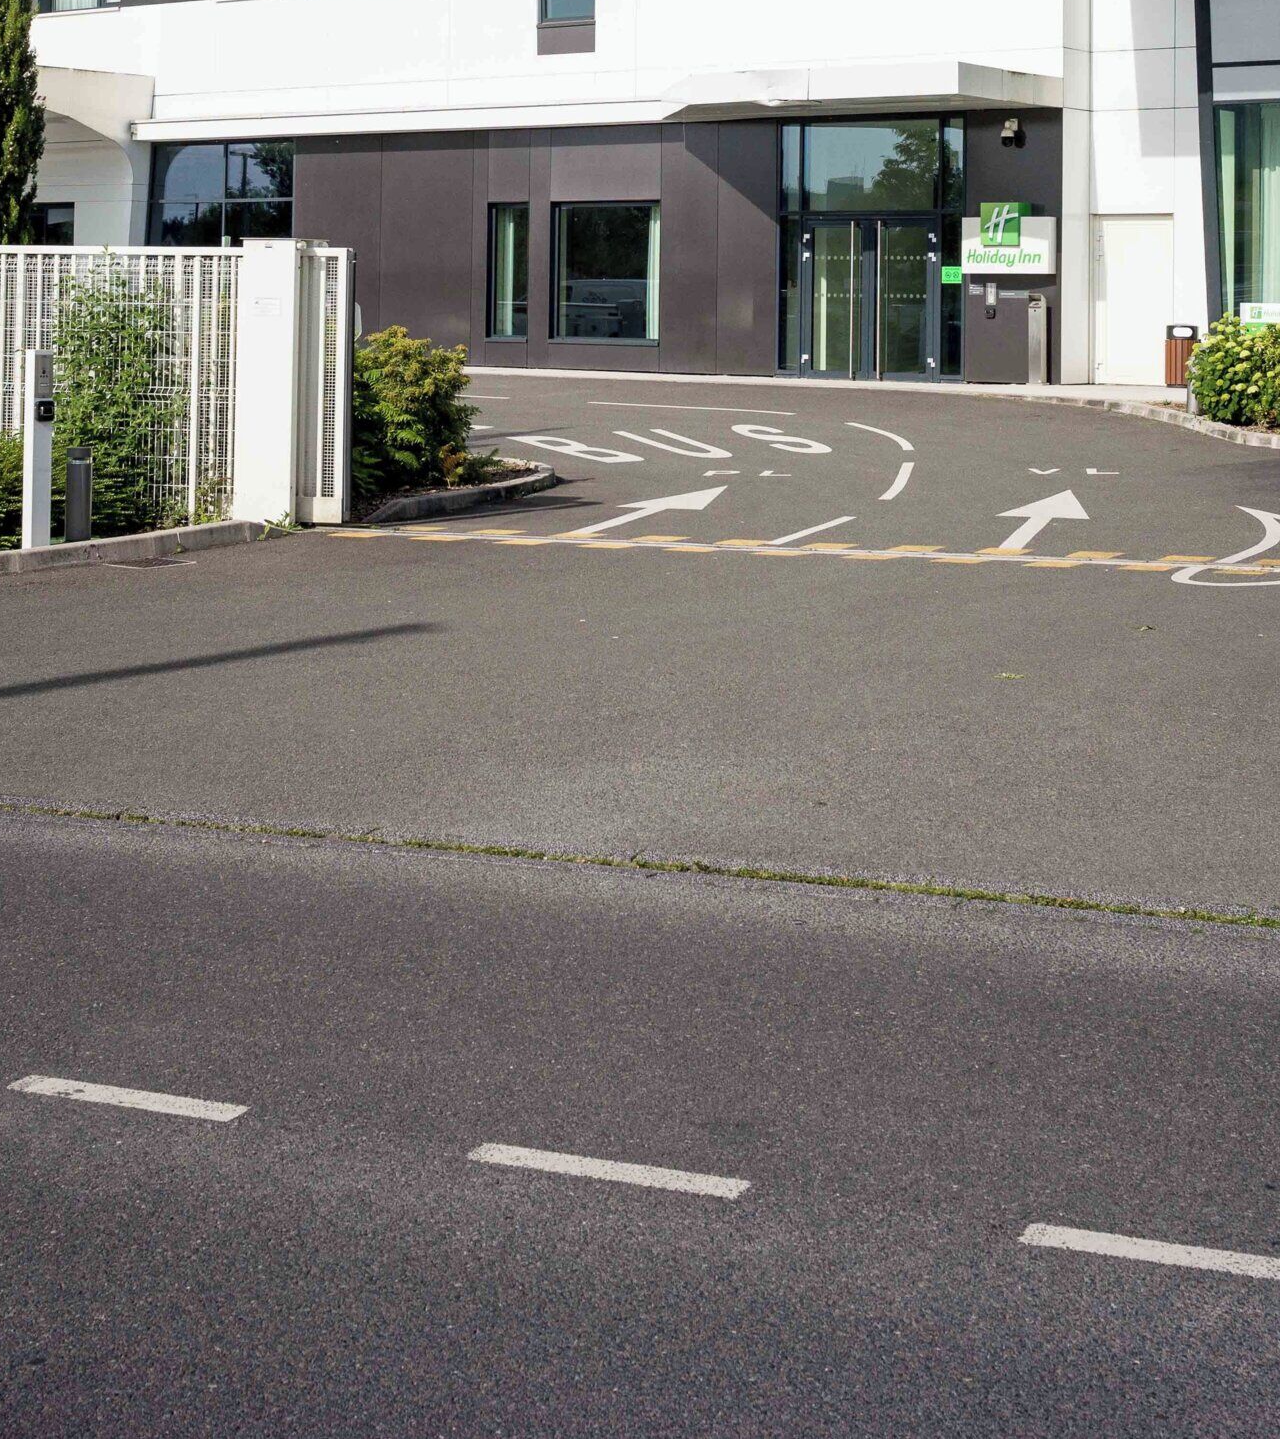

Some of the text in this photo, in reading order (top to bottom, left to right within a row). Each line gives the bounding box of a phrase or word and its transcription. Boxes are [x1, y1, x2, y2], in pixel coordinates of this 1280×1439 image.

[966, 248, 1042, 267] Holiday Inn
[506, 424, 833, 464] BUS
